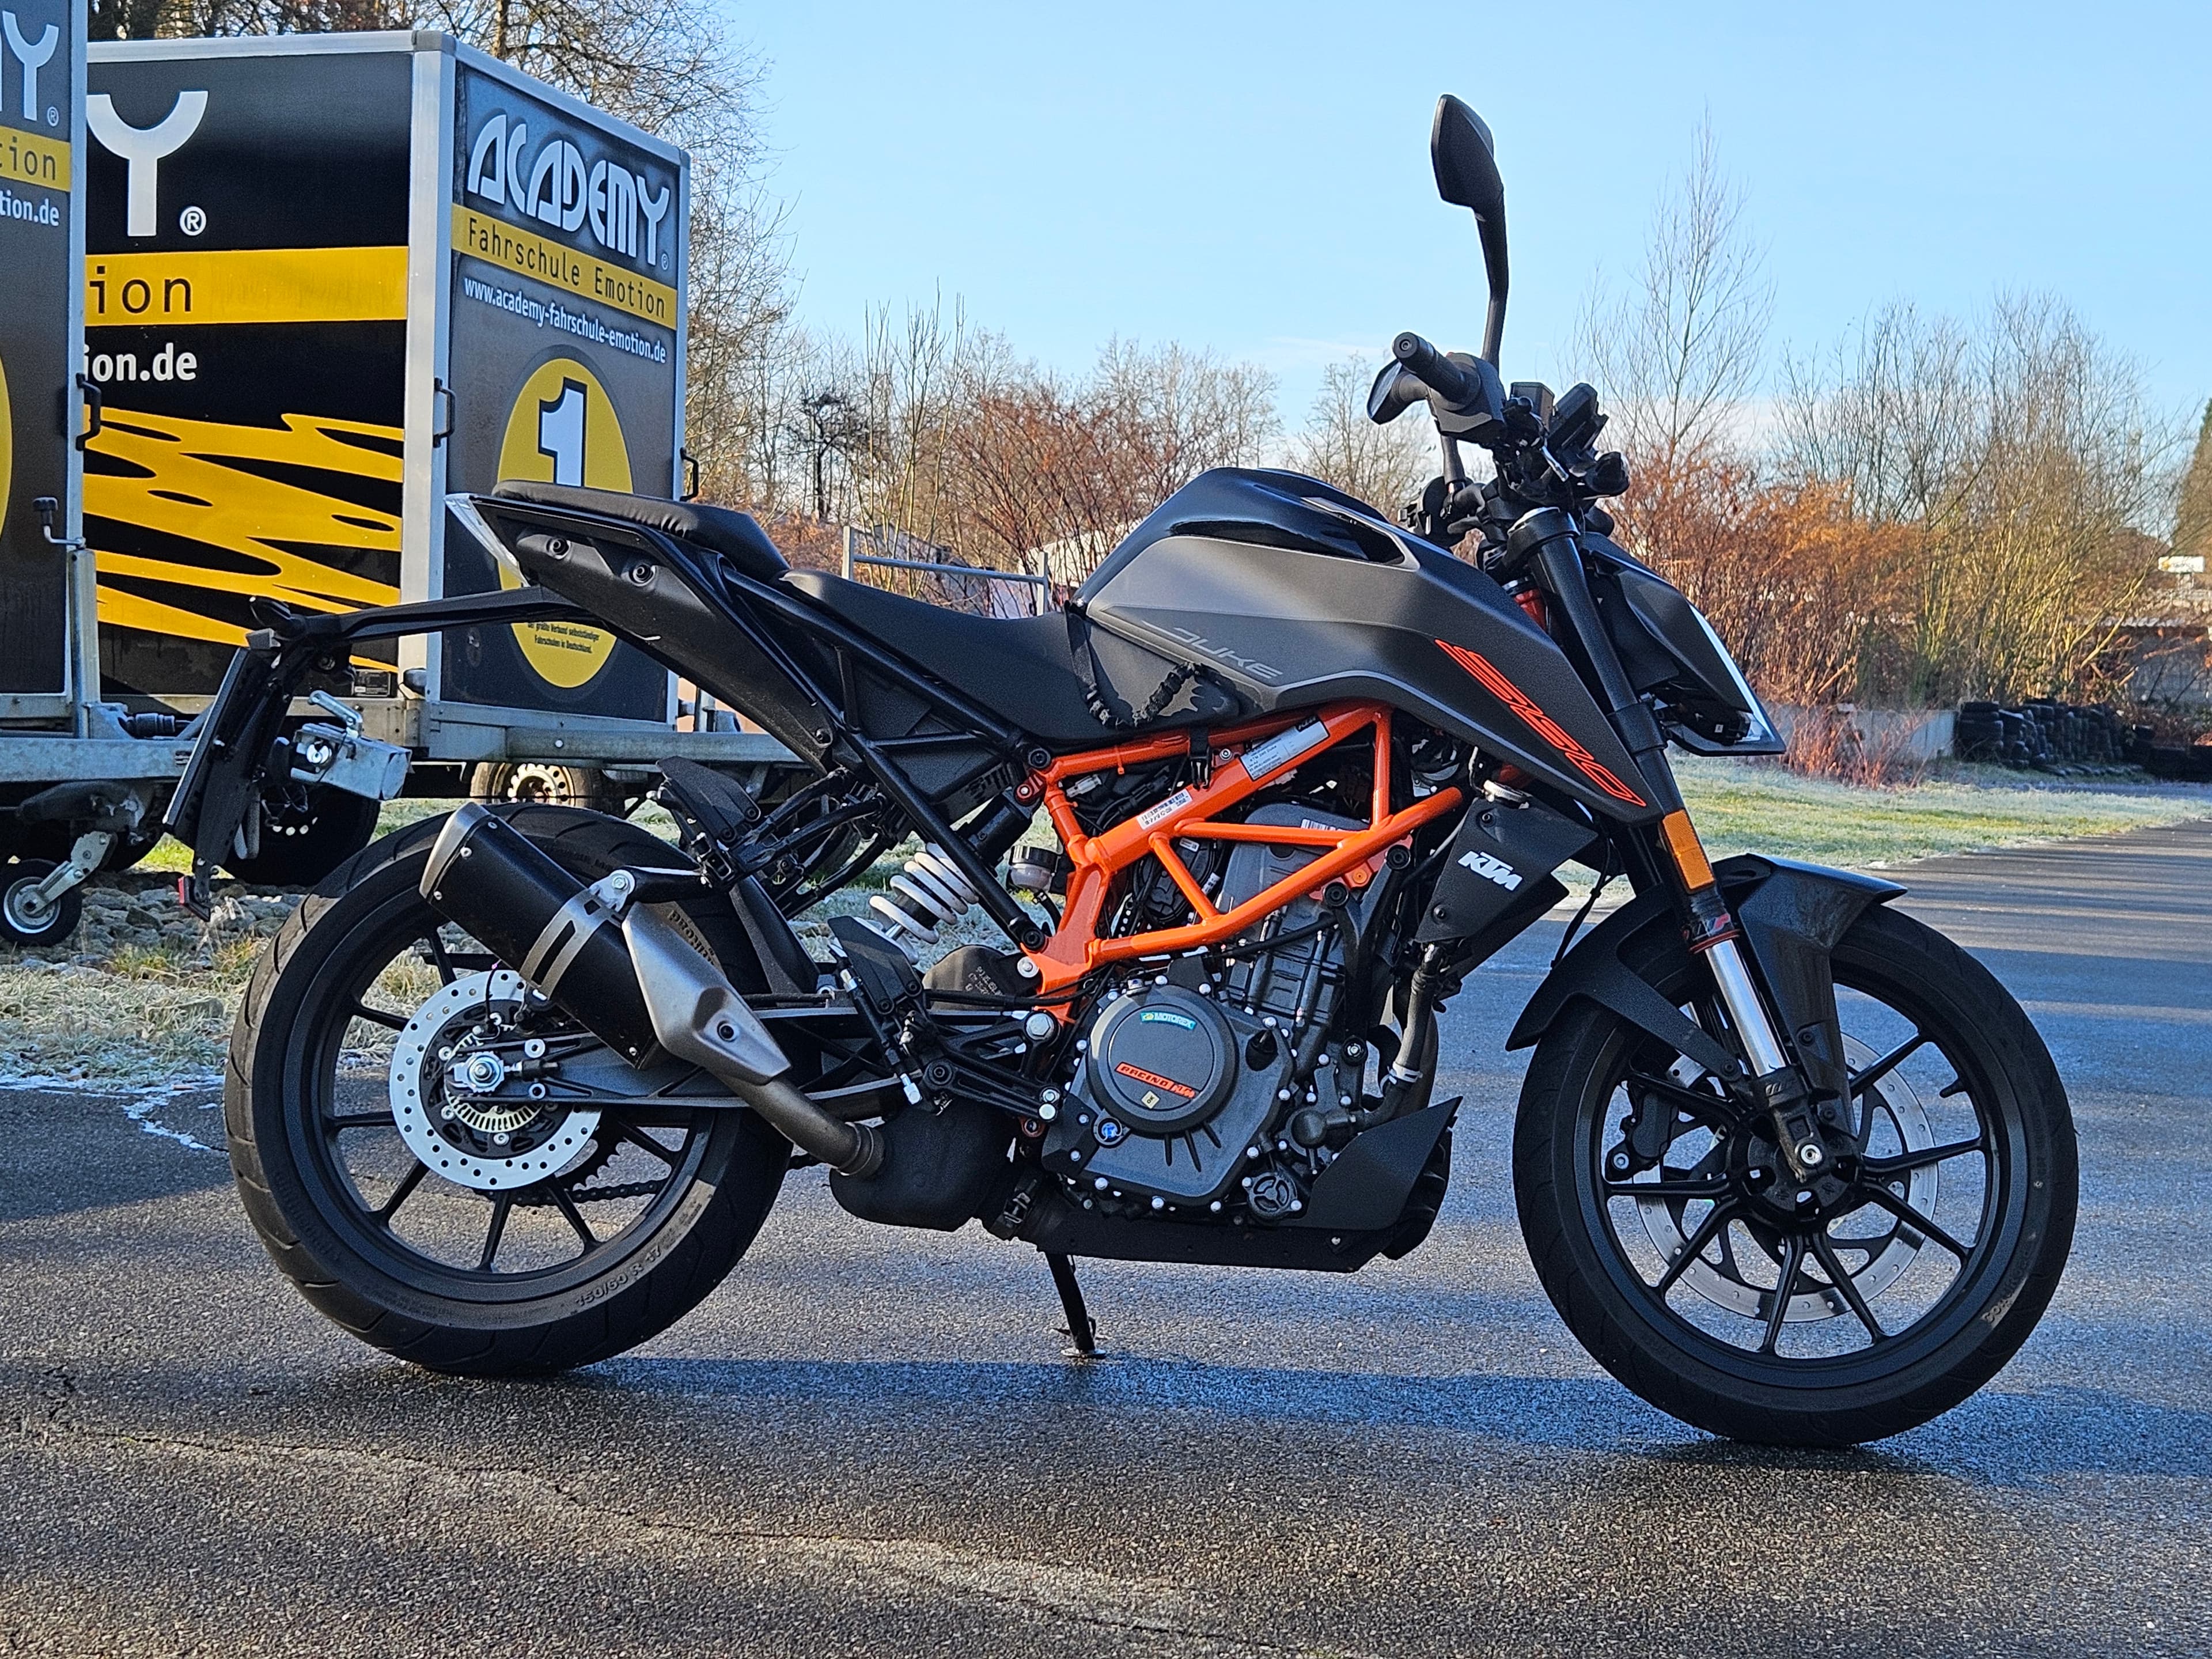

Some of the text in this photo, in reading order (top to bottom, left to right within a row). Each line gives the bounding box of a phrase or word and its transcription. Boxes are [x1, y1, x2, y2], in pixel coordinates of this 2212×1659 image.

[0, 137, 56, 180] ion
[467, 114, 670, 266] ACADEMY
[89, 266, 192, 314] ion
[469, 217, 665, 319] Fahrschule Emotion
[464, 276, 666, 364] www.academy-fahrschule-emotion.de
[1142, 620, 1283, 679] DUKE
[1457, 850, 1523, 891] KTM
[1155, 1012, 1192, 1028] MOTOREX
[1146, 1095, 1155, 1104] OK
